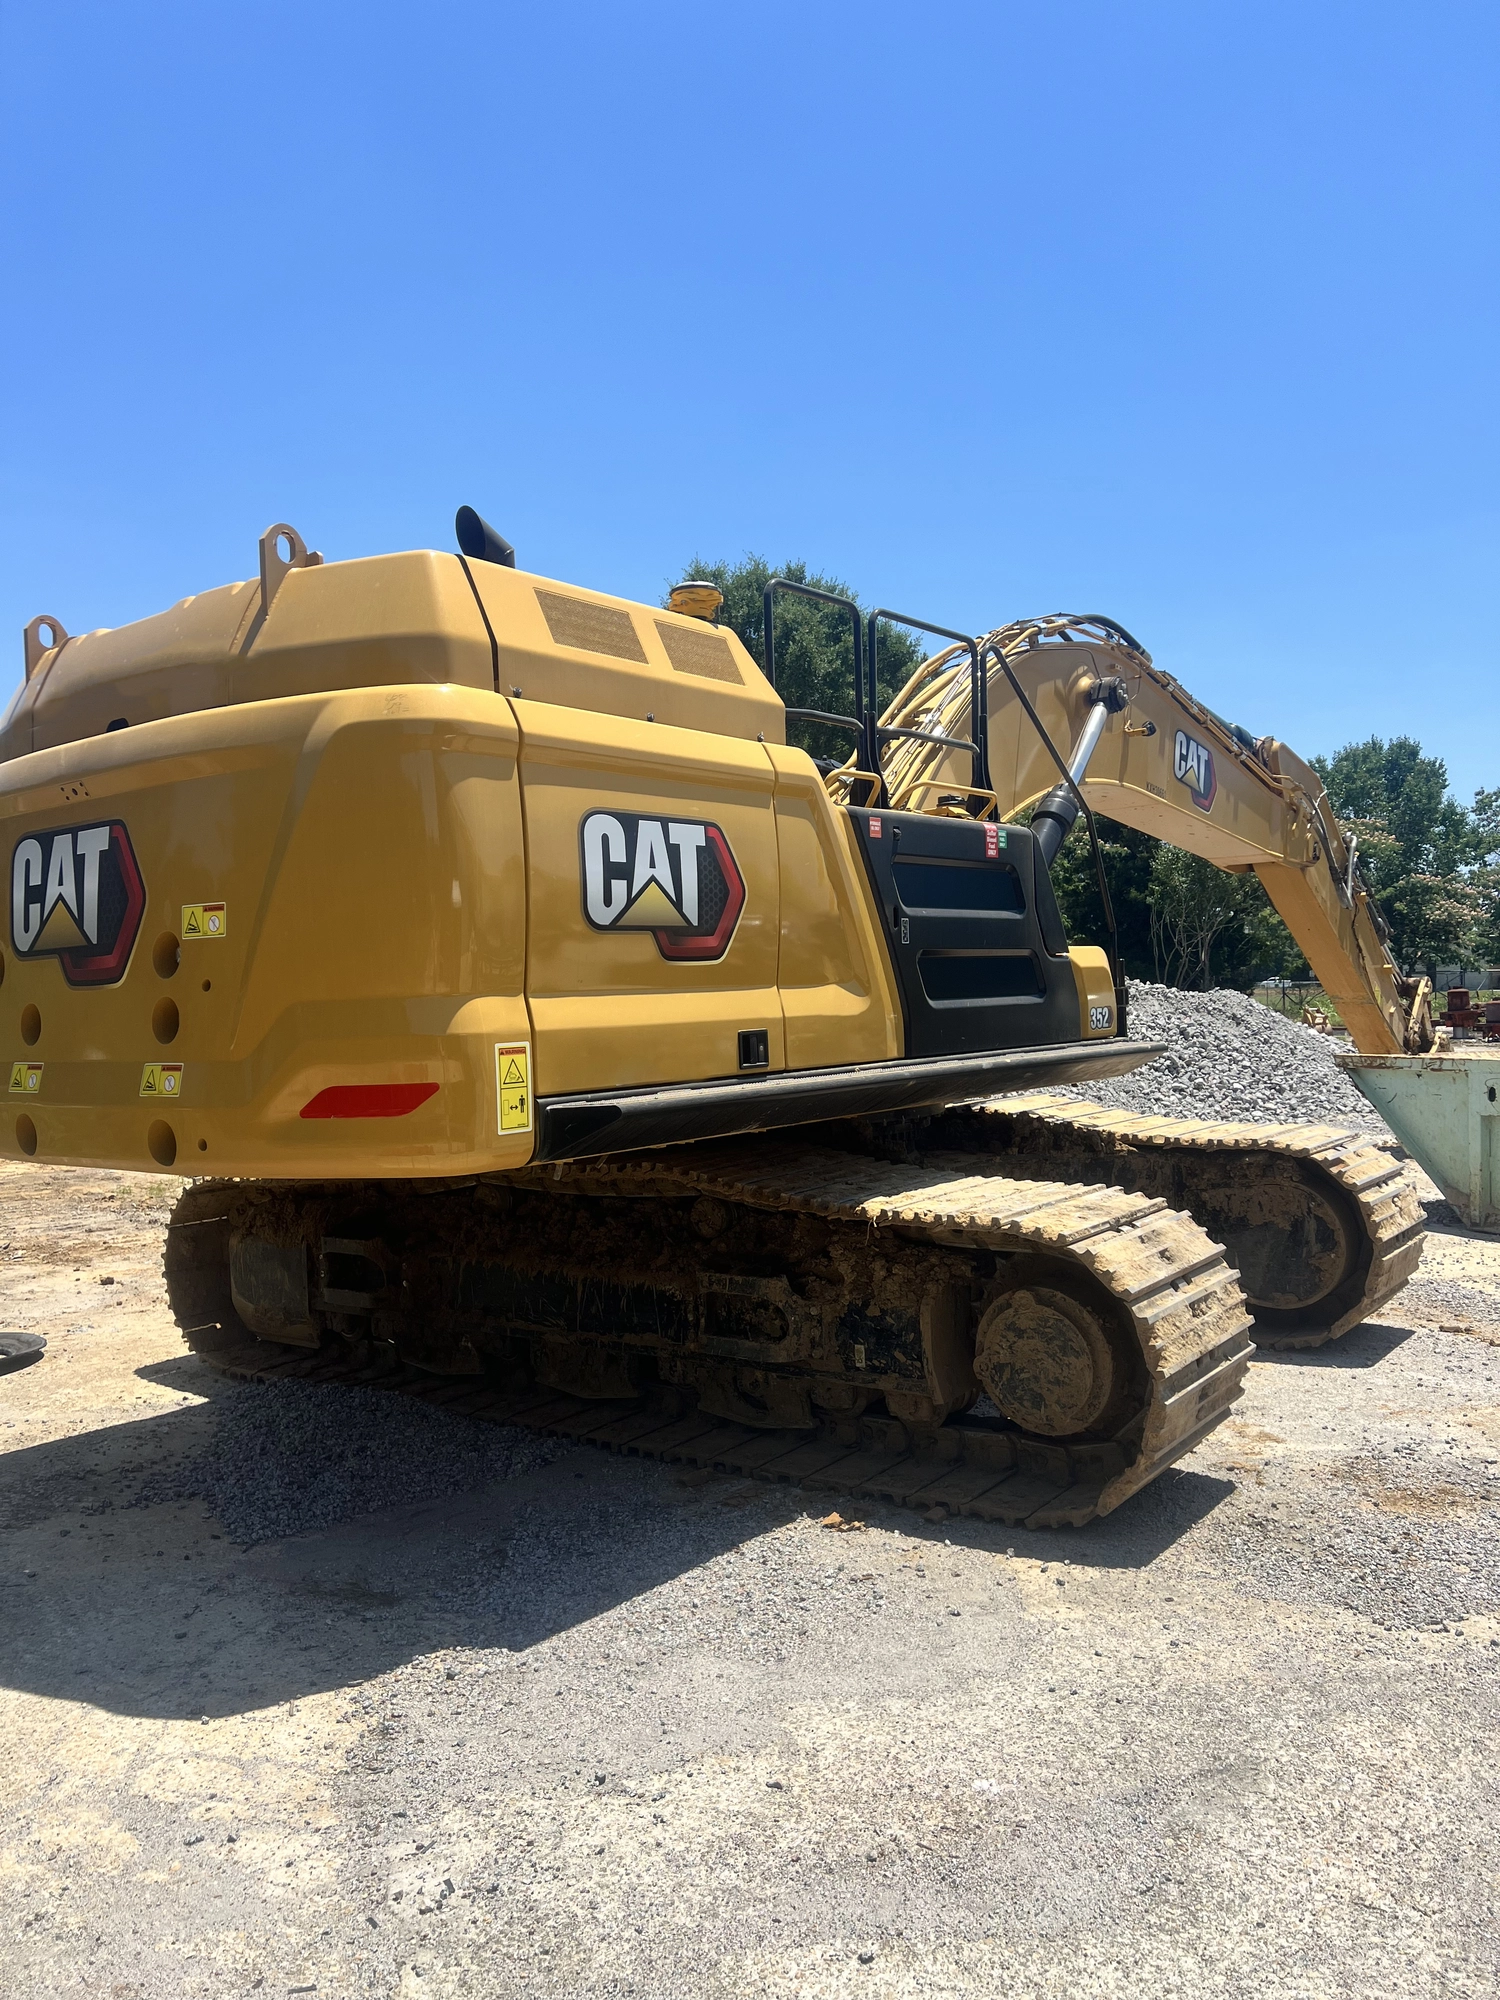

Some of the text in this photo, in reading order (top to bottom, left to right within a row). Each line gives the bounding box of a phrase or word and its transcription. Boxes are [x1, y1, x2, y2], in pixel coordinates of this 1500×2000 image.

[1174, 731, 1208, 793] CAT
[13, 826, 110, 951] CAT
[584, 814, 706, 926] CAT
[1090, 1007, 1109, 1028] 352
